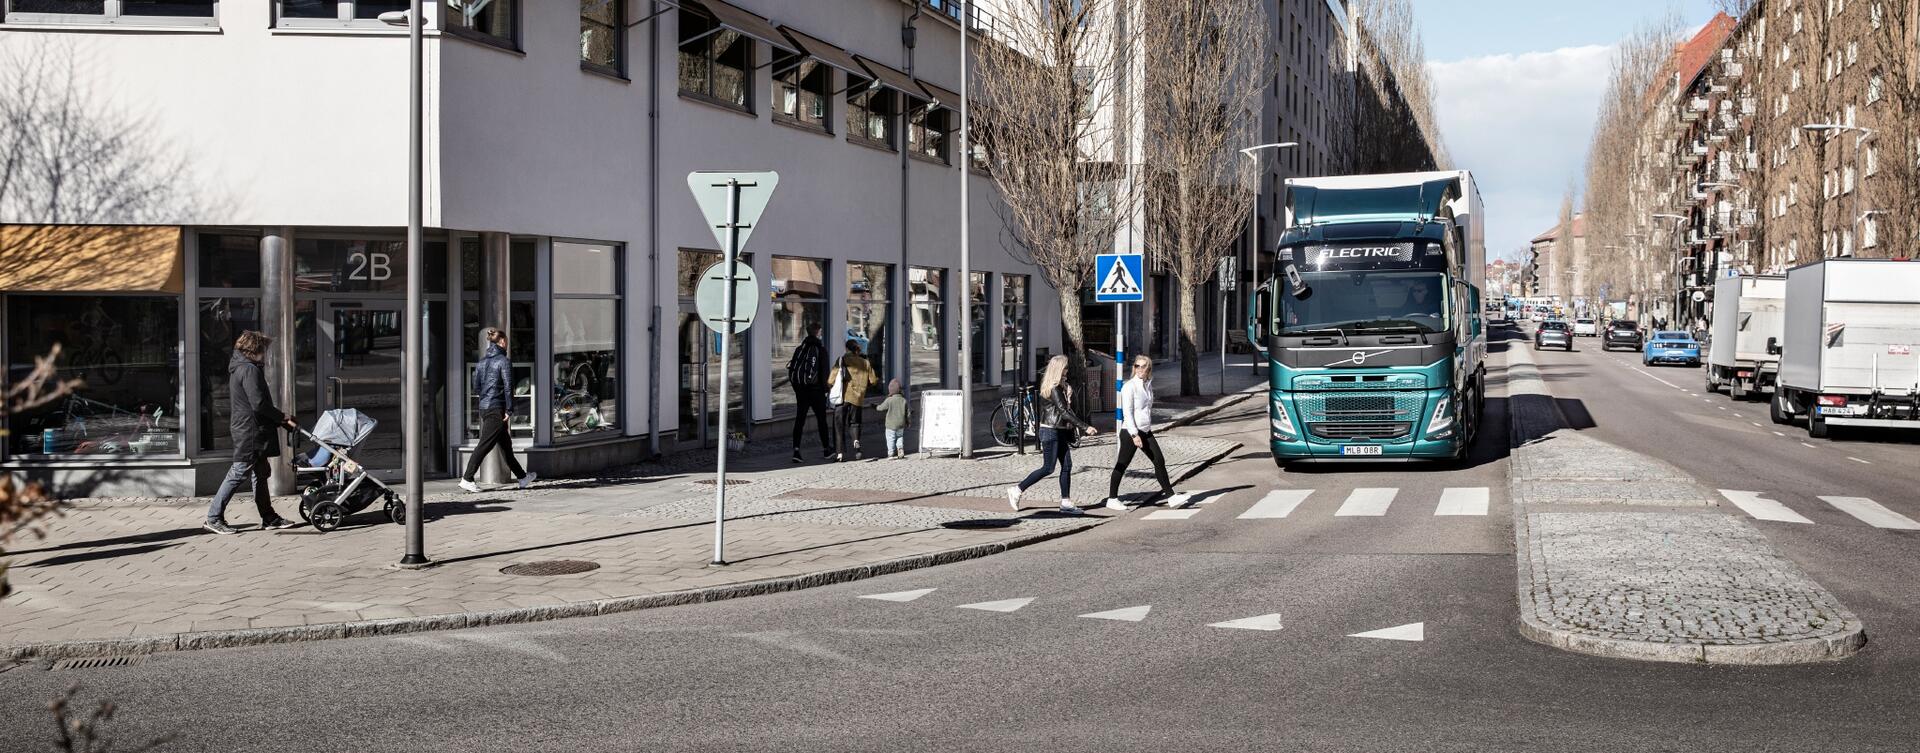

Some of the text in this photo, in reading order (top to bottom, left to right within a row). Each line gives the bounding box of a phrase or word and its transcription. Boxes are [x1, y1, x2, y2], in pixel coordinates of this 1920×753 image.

[1319, 246, 1401, 258] ELECTRIC
[349, 252, 391, 280] 2B
[1346, 446, 1361, 454] MLB
